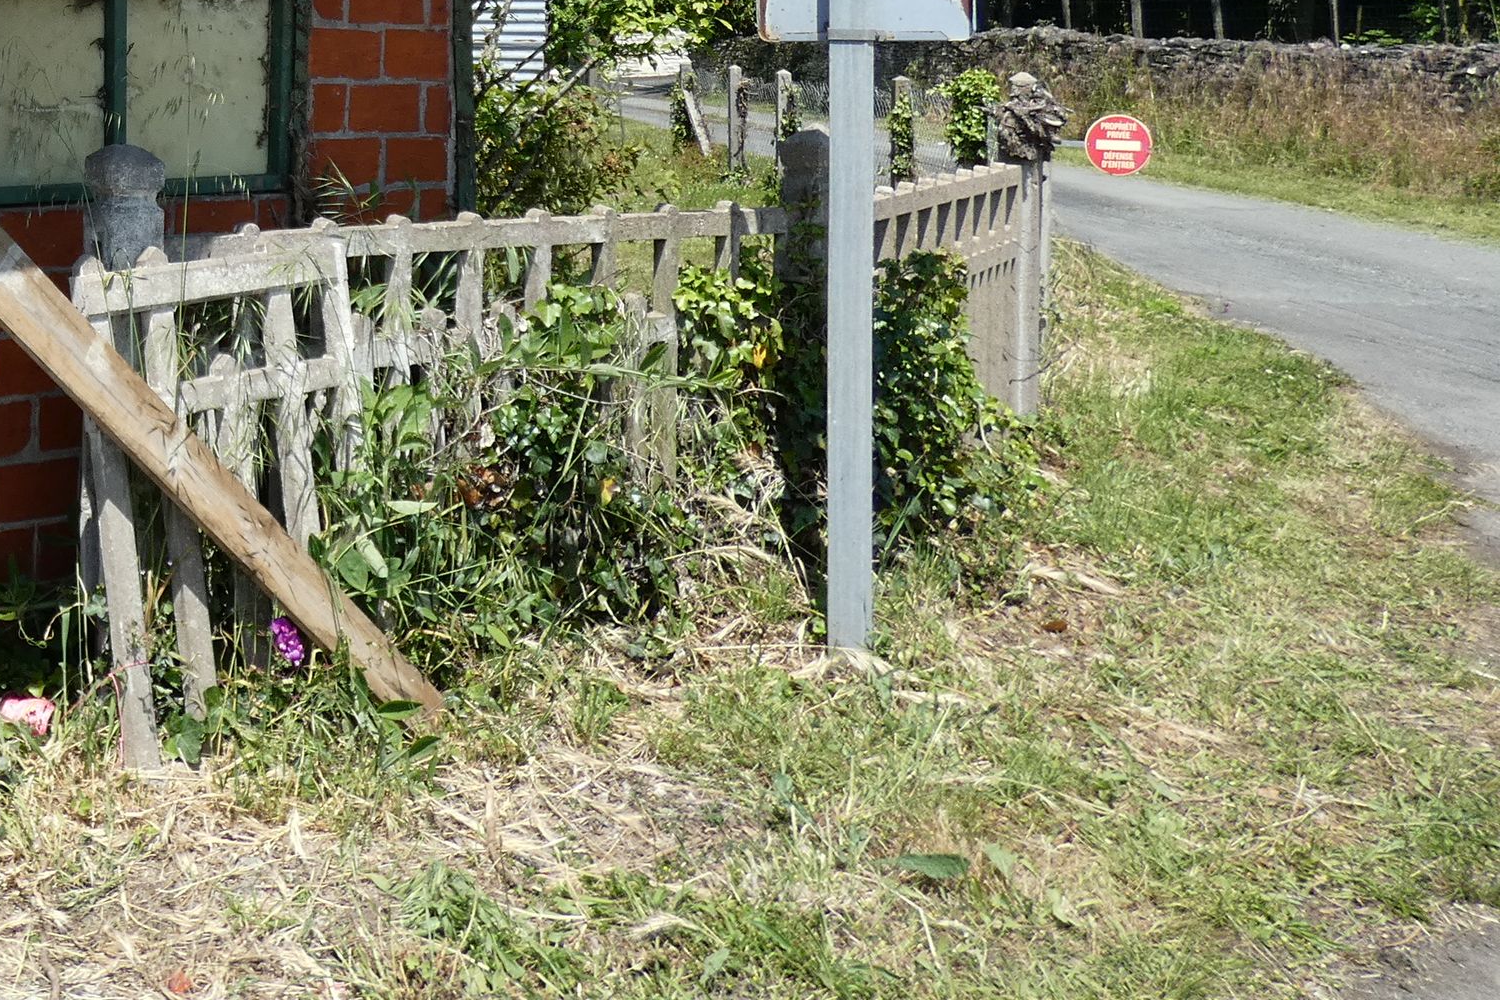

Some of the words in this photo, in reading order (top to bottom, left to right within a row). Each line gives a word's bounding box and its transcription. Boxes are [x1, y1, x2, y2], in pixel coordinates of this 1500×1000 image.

[1100, 121, 1137, 131] PROPRIÉTÉ
[1103, 151, 1134, 161] DÉFENSE
[1101, 160, 1135, 169] D'ENTRER
